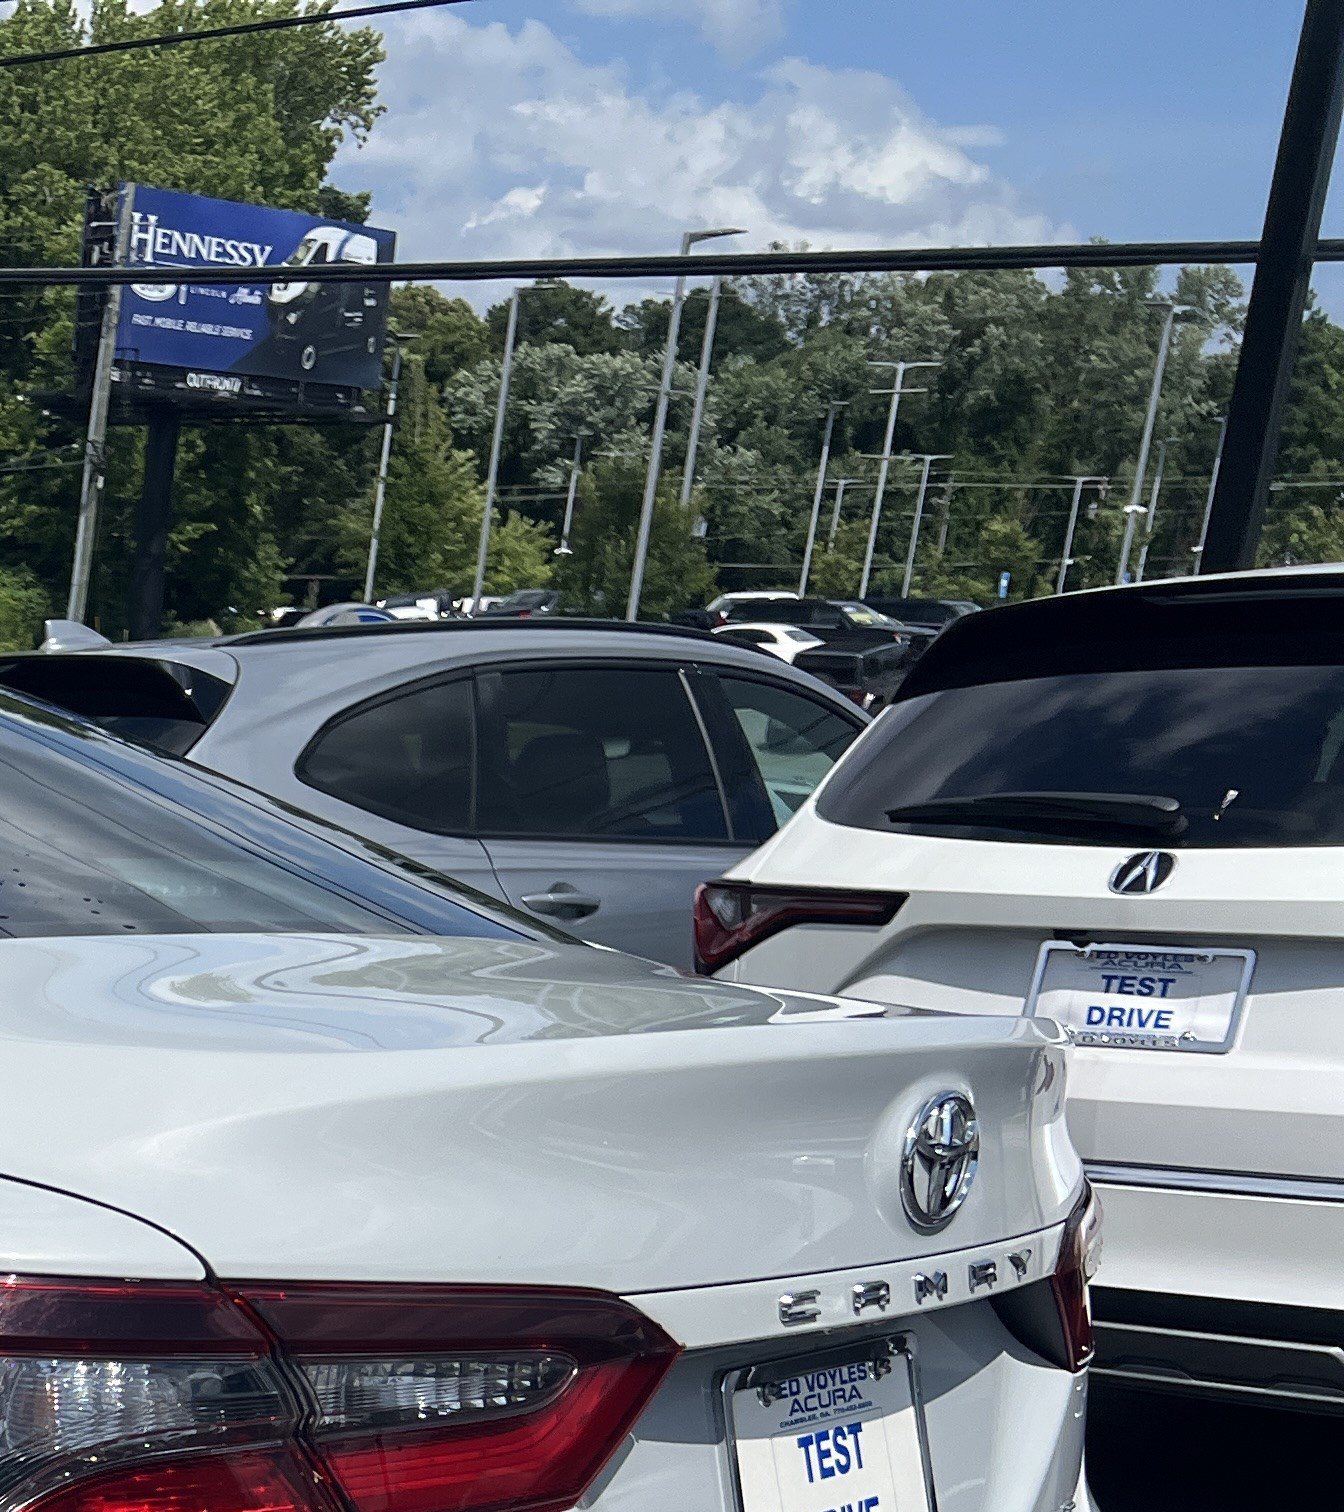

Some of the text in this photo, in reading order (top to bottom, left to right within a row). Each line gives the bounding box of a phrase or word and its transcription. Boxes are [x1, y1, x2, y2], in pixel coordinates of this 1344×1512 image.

[130, 211, 273, 268] HENNESSY
[1101, 959, 1184, 971] ACURA
[1101, 974, 1177, 998] TEST
[1086, 1005, 1175, 1029] DRIVE
[779, 1248, 1032, 1327] CAMRY
[804, 1362, 868, 1393] VOYLES
[789, 1384, 863, 1417] ACURA
[797, 1422, 863, 1483] TEST
